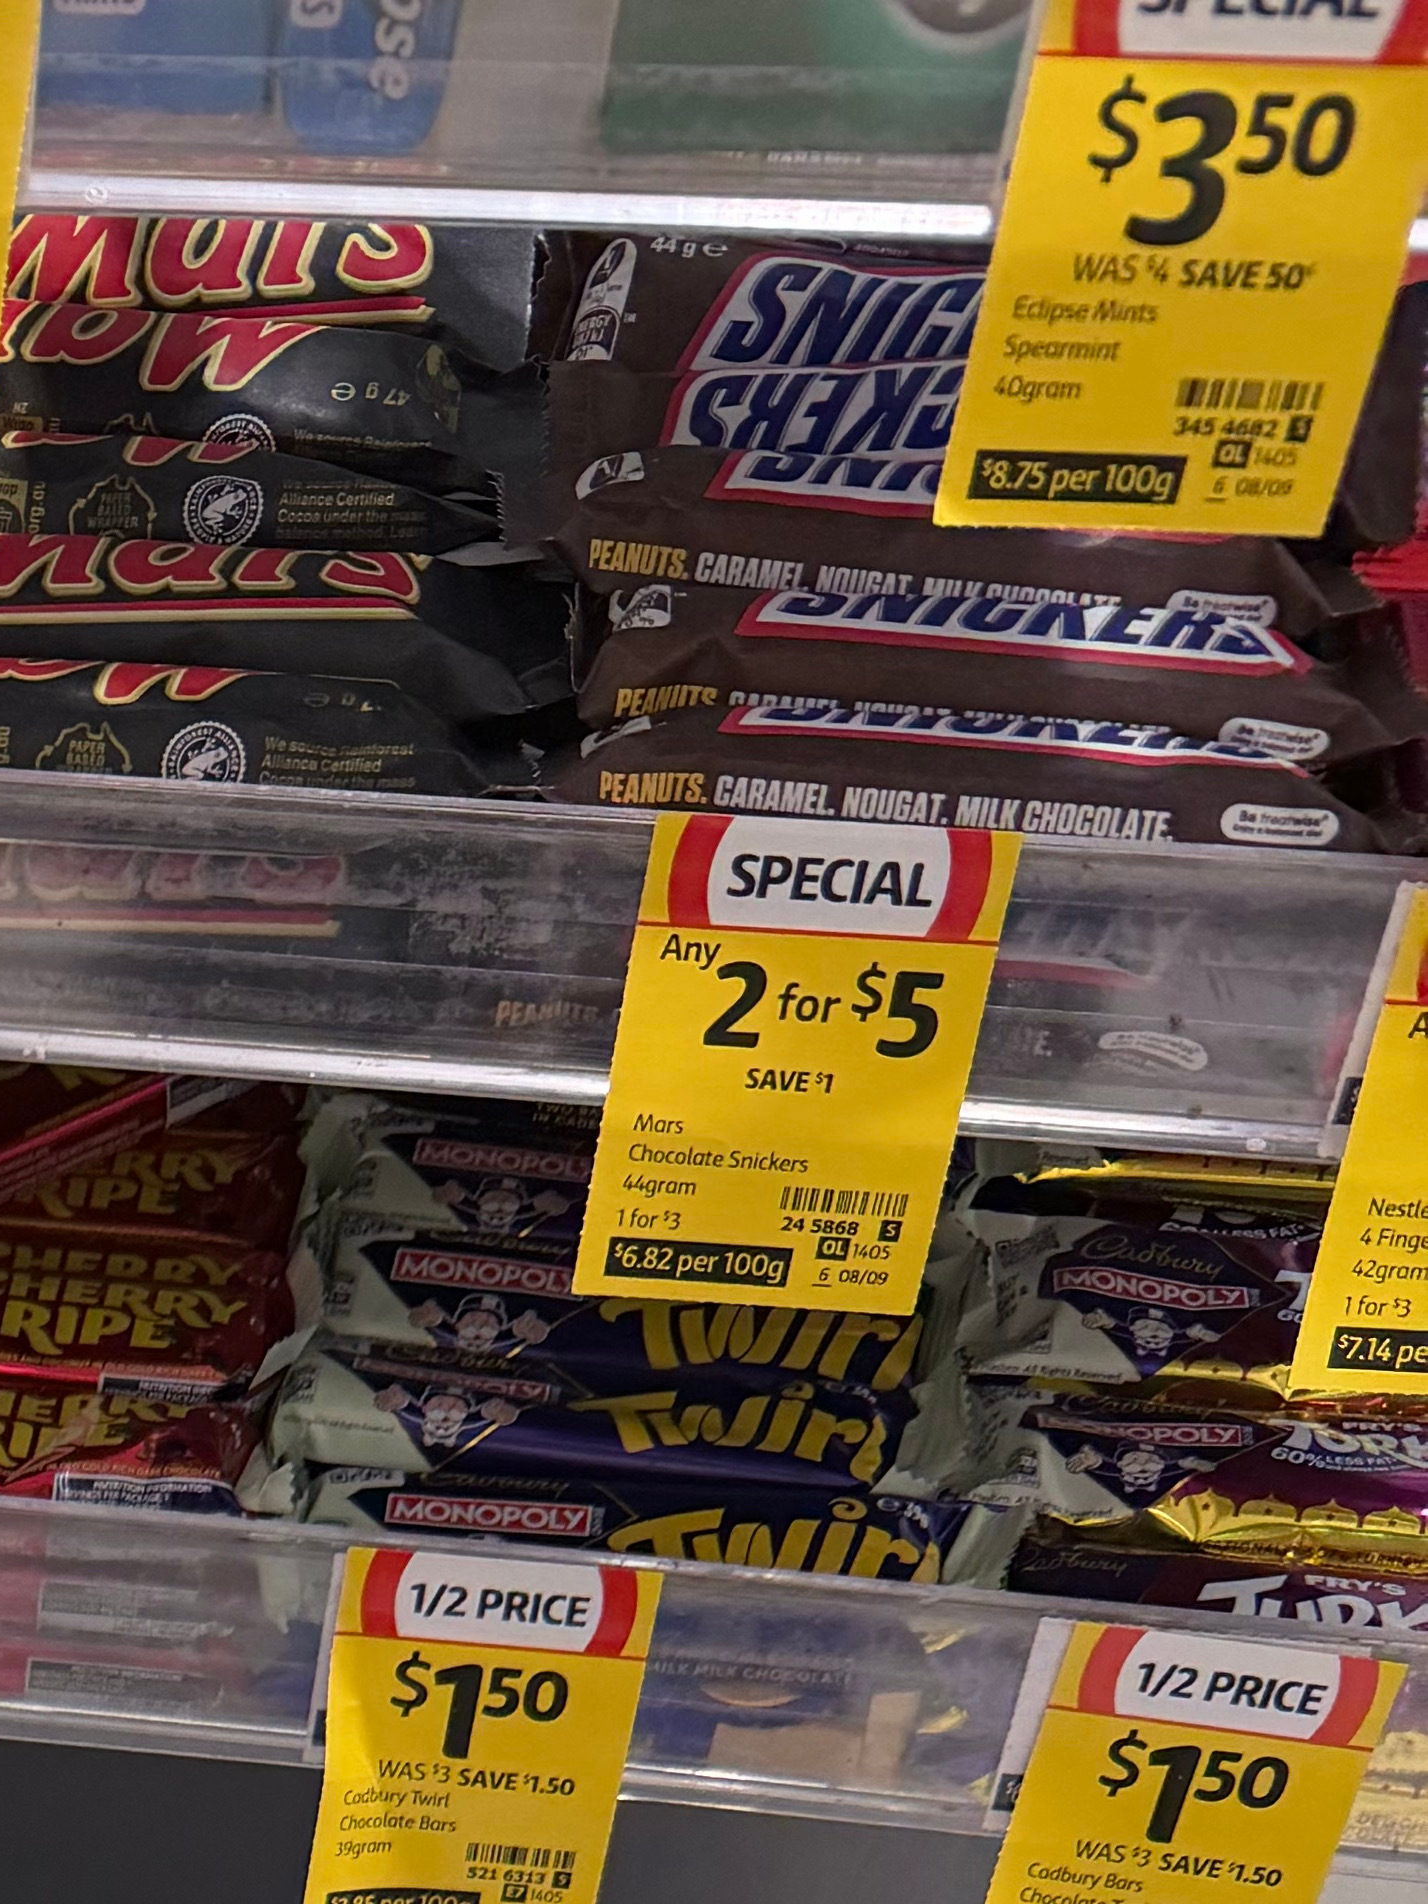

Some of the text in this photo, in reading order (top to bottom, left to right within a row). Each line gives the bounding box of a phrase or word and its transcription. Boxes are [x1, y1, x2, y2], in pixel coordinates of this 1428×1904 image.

[1004, 334, 1121, 364] Spearmint
[599, 771, 1176, 844] PEANUTS. CARAMEL. NOUGAT. MILK CHOCOLATE.
[726, 852, 933, 908] SPECIAL
[660, 933, 722, 971] Any
[702, 960, 767, 1049] 2
[778, 983, 841, 1024] for
[745, 1067, 810, 1094] SAVE
[633, 1112, 684, 1135] Mars
[628, 1143, 810, 1174] Chocolate Snickers
[622, 1173, 697, 1200] 44gram
[675, 1251, 785, 1281] per 100g
[1059, 1270, 1246, 1308] MONOPOLY
[0, 1300, 174, 1356] RIPE
[392, 1500, 588, 1533] MONOPOLY
[410, 1582, 592, 1628] 1/2 PRICE
[1137, 1661, 1329, 1717] 1/2 PRICE
[344, 1788, 450, 1808] Cadbury Twirl
[340, 1814, 457, 1833] Chocolate Bars
[335, 1839, 392, 1859] 39gram
[1076, 1838, 1222, 1879] WAS SAVE
[1027, 1861, 1143, 1894] Cadbury Bars
